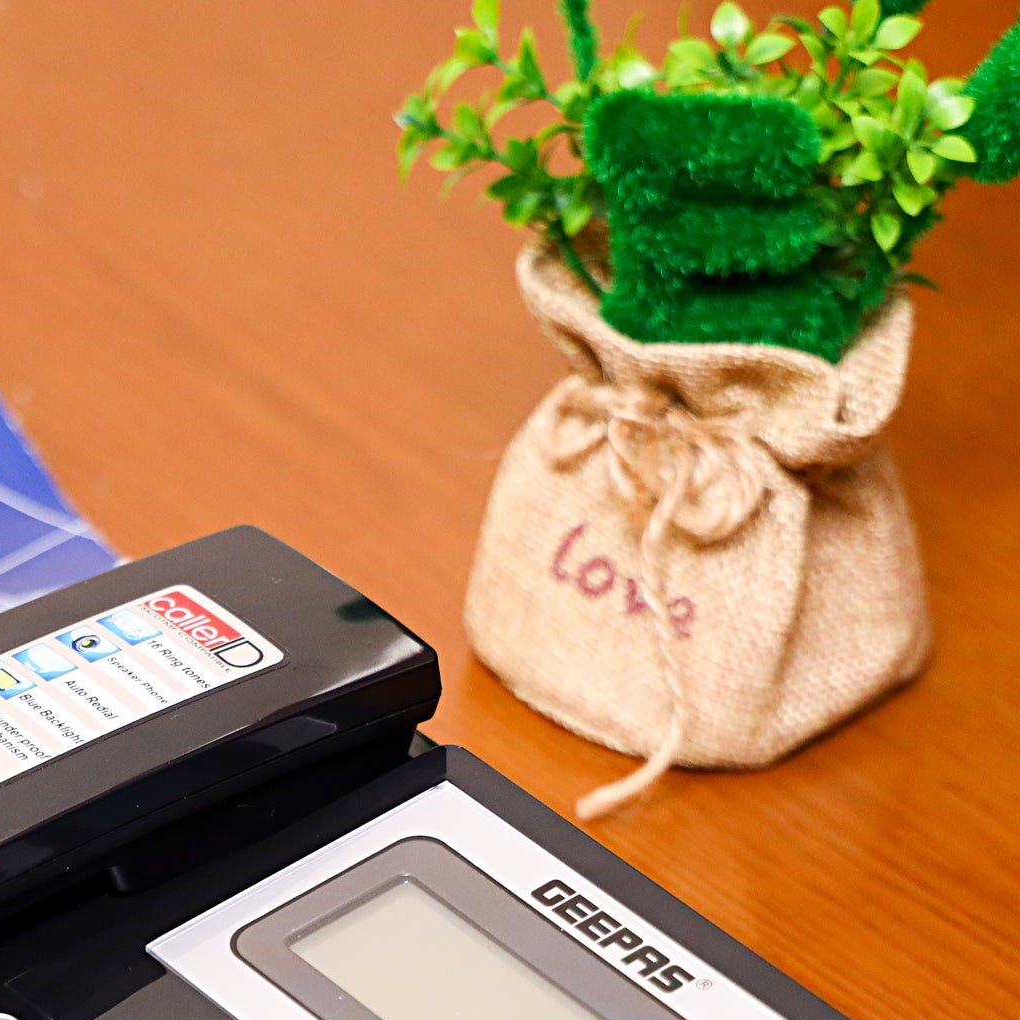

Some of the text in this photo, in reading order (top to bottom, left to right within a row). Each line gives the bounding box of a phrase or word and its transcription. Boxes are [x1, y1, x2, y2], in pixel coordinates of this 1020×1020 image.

[147, 639, 211, 689] 16 Ring tones
[178, 630, 232, 672] COMPATIBLE
[63, 680, 119, 720] Auto Redial
[106, 656, 168, 705] Speaker Phone
[18, 693, 84, 745] Blue Backlight
[18, 738, 53, 760] proof
[530, 878, 695, 993] GEEPAS
